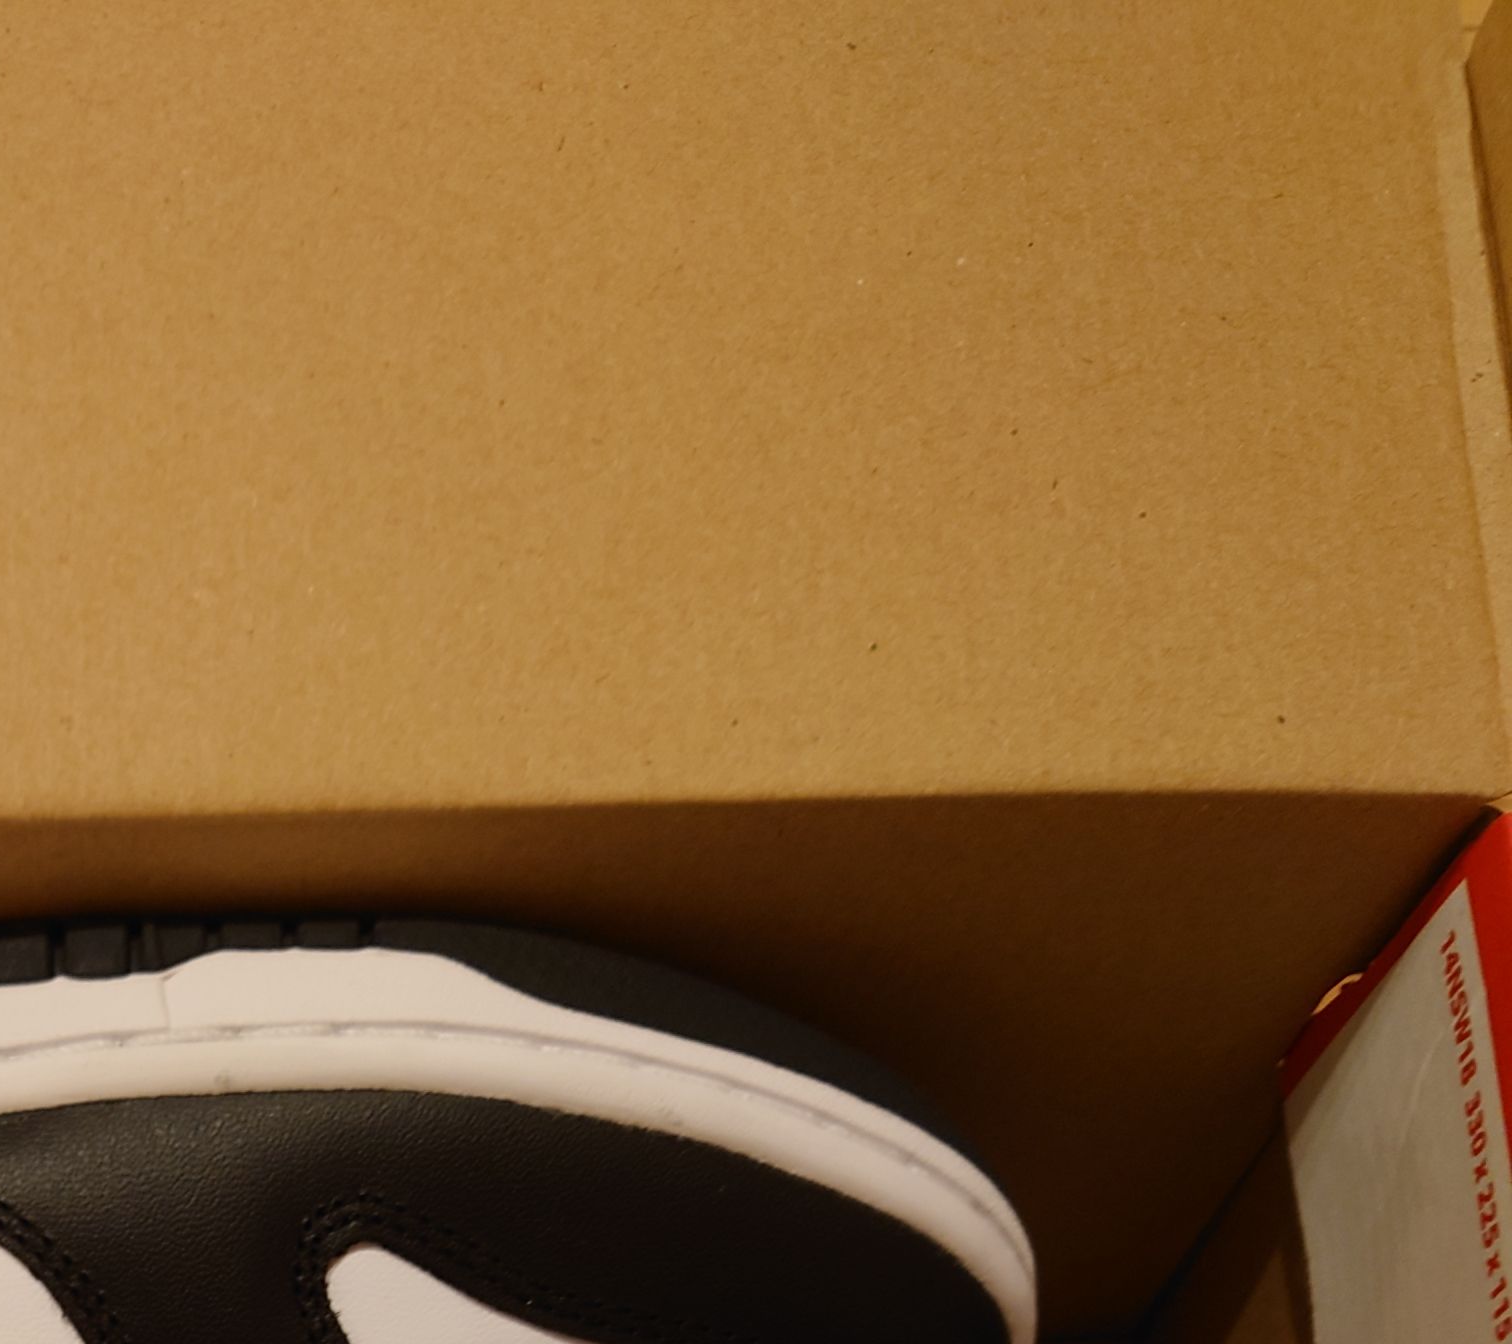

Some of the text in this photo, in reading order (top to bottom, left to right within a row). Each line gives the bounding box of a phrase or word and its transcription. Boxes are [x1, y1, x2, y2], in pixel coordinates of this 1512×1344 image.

[1439, 932, 1478, 1087] 14NSW18
[1464, 1093, 1488, 1158] 330
[1476, 1185, 1501, 1250] 225
[1489, 1278, 1512, 1342] 115
